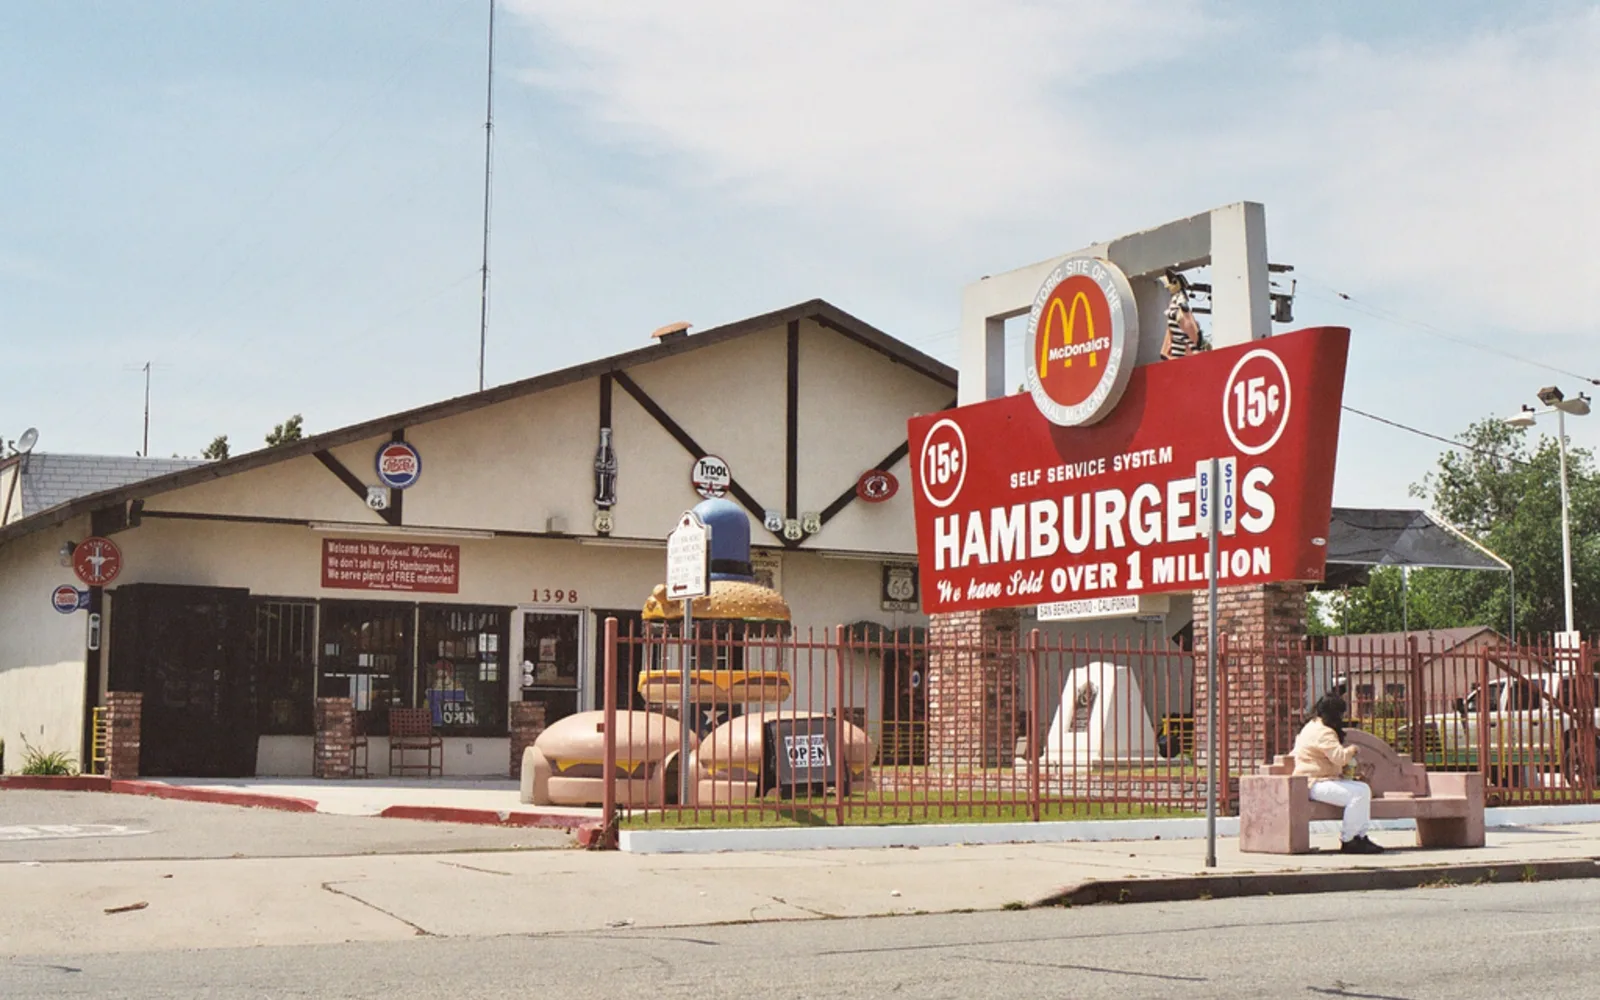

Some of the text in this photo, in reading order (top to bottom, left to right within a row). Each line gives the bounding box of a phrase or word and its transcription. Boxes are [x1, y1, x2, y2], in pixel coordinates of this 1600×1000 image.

[1028, 260, 1121, 334] HISTORIC SITE OF THE
[1048, 336, 1110, 361] McDonald's
[1233, 378, 1280, 430] 15¢
[700, 461, 727, 477] TYDOL
[928, 442, 960, 485] 15¢
[1010, 446, 1173, 488] SELF SERVICE SYSTEM
[370, 499, 384, 508] 66
[1200, 472, 1209, 517] BUS
[1224, 463, 1233, 524] STOP
[768, 521, 779, 530] 66
[935, 466, 1275, 571] HAMBURGES
[327, 541, 359, 554] Welcome
[360, 543, 367, 554] to
[368, 543, 380, 555] the
[327, 557, 339, 568] We
[360, 558, 372, 569] sell
[372, 561, 385, 572] any
[443, 562, 455, 573] but
[327, 568, 339, 579] We
[340, 571, 360, 580] serve
[361, 571, 385, 583] plenty
[386, 571, 394, 582] of
[395, 571, 416, 582] FREE
[937, 546, 1271, 603] We have Sold OVER 1 MILLION
[532, 588, 578, 604] 1398
[891, 579, 910, 597] 66
[443, 711, 476, 725] OPEN
